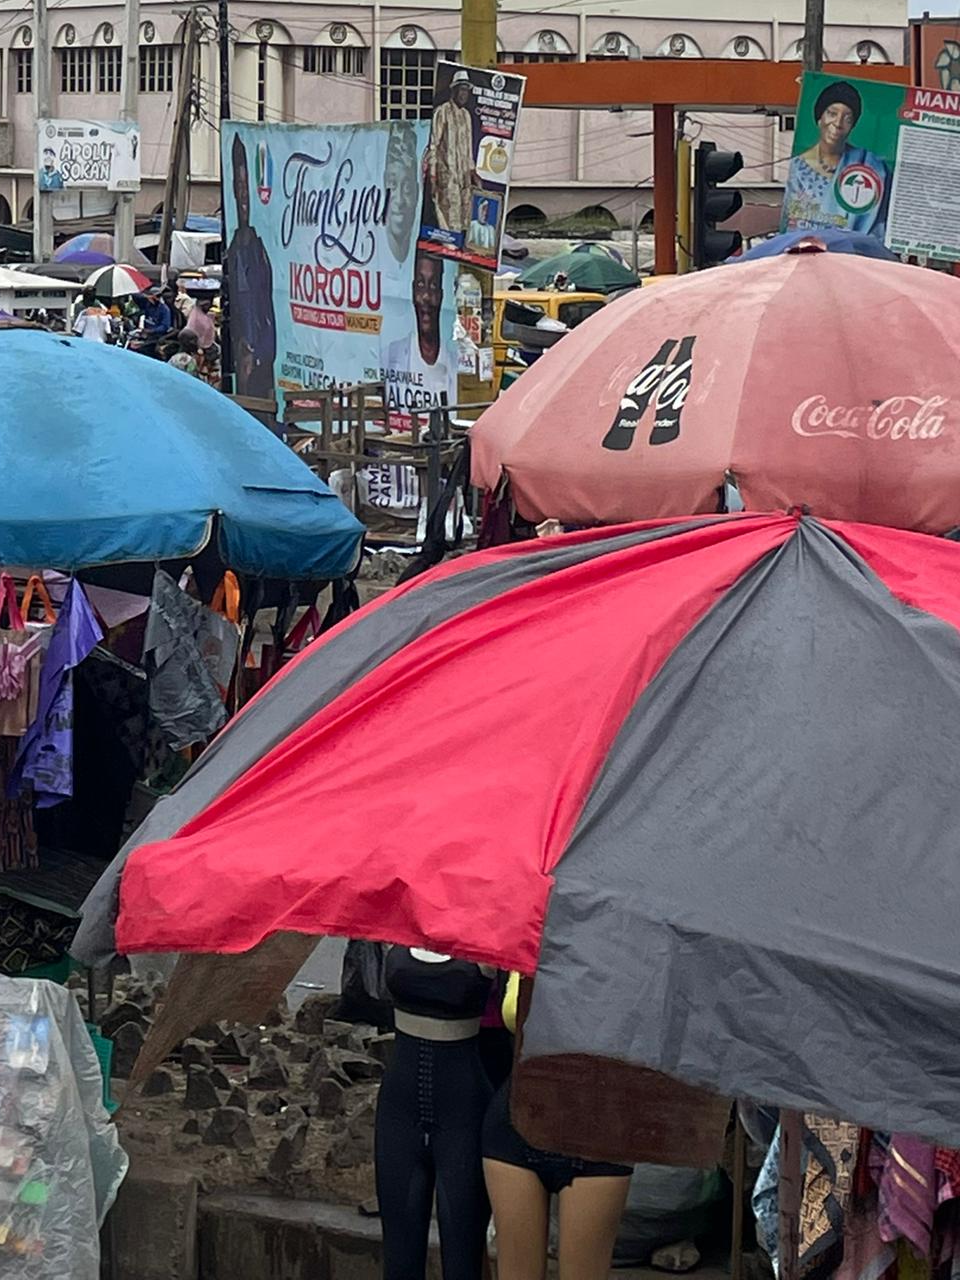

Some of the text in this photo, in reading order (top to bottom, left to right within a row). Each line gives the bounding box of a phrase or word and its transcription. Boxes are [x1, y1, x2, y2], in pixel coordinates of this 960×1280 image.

[914, 90, 960, 111] MAN
[281, 141, 353, 249] Thank
[289, 262, 382, 311] IKORODU
[791, 394, 951, 441] Coca-Cola
